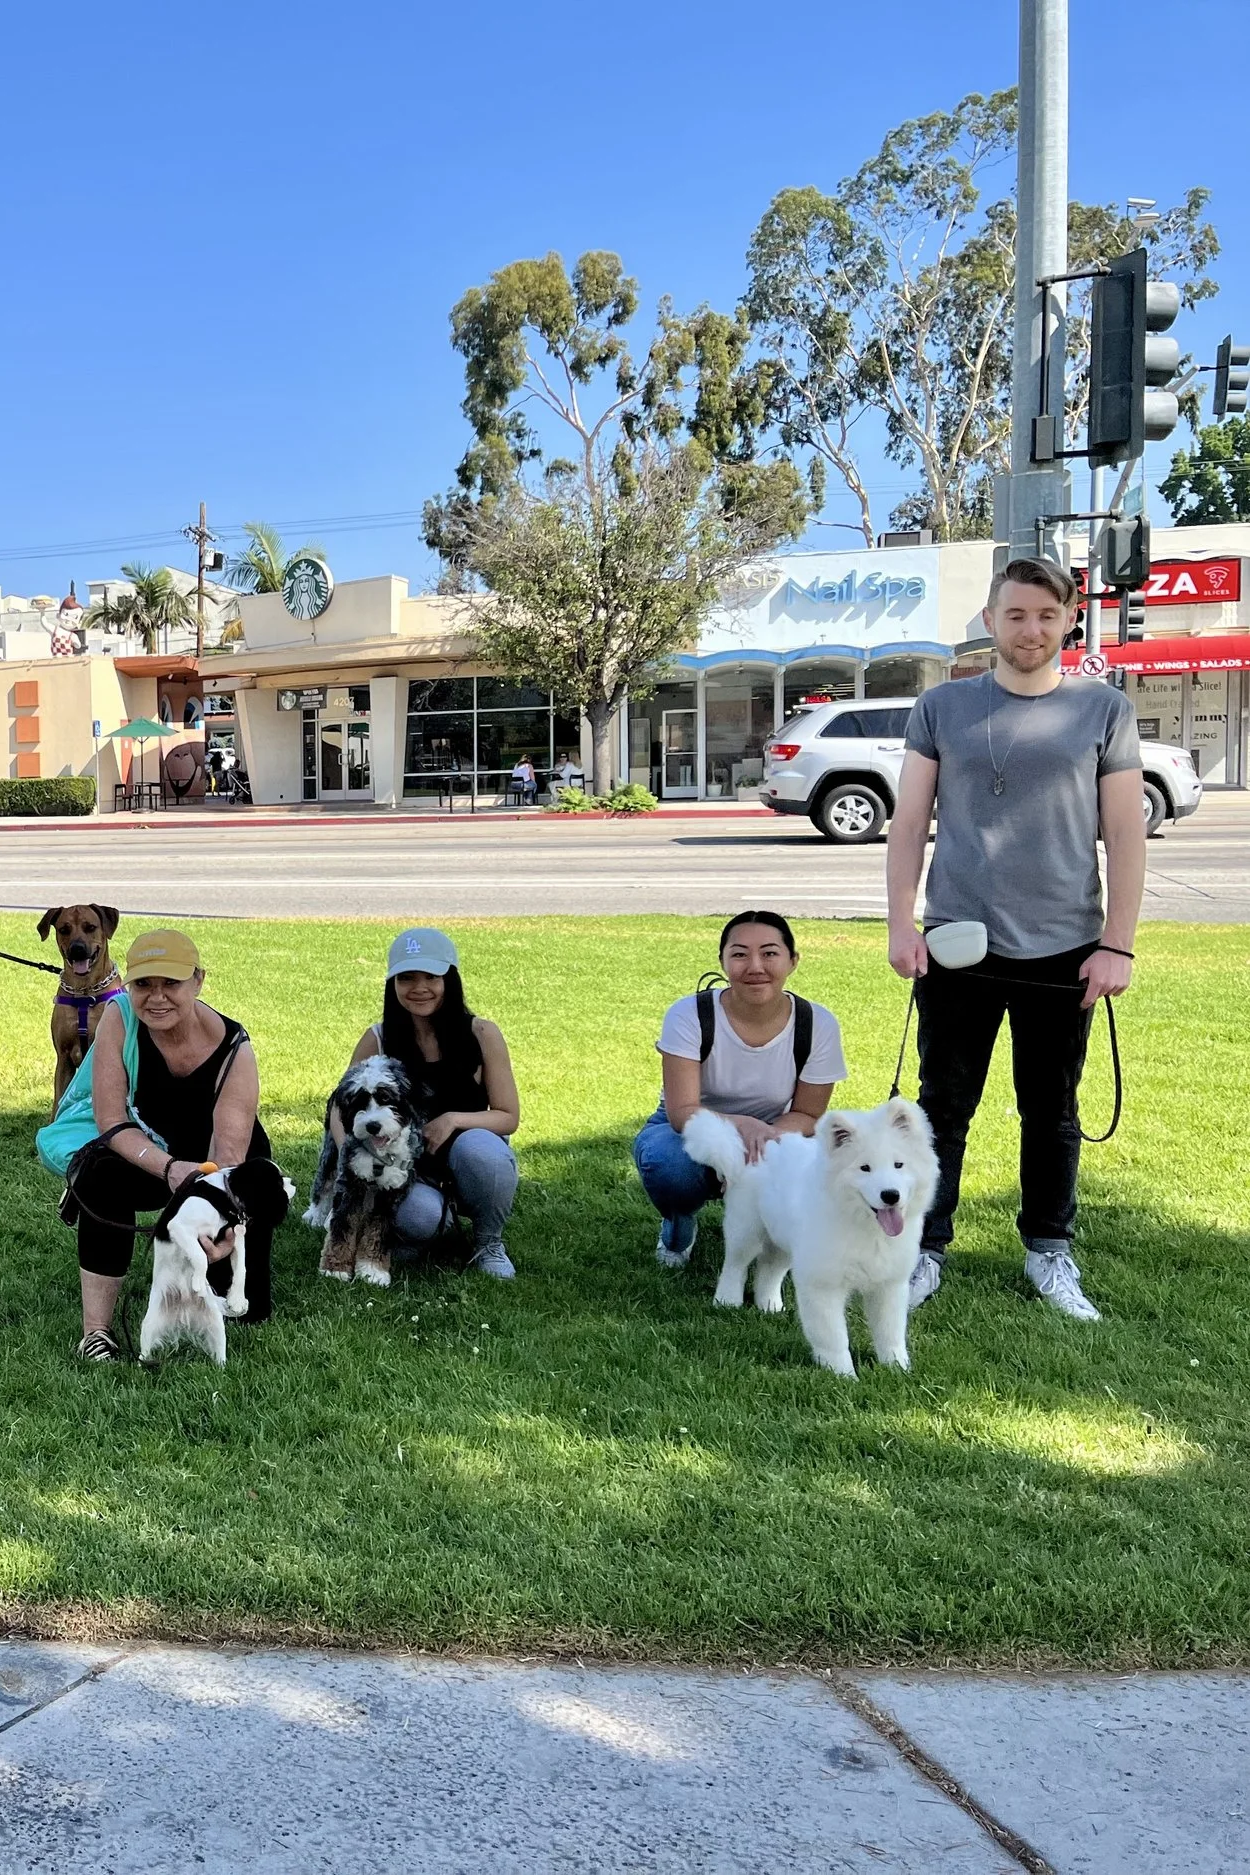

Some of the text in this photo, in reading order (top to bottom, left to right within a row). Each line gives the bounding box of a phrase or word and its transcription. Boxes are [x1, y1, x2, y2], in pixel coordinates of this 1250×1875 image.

[786, 569, 925, 608] Nail Spa
[1153, 661, 1190, 670] WINGS
[1200, 659, 1242, 668] SALADS
[333, 697, 355, 707] 4207
[406, 937, 421, 954] LA
